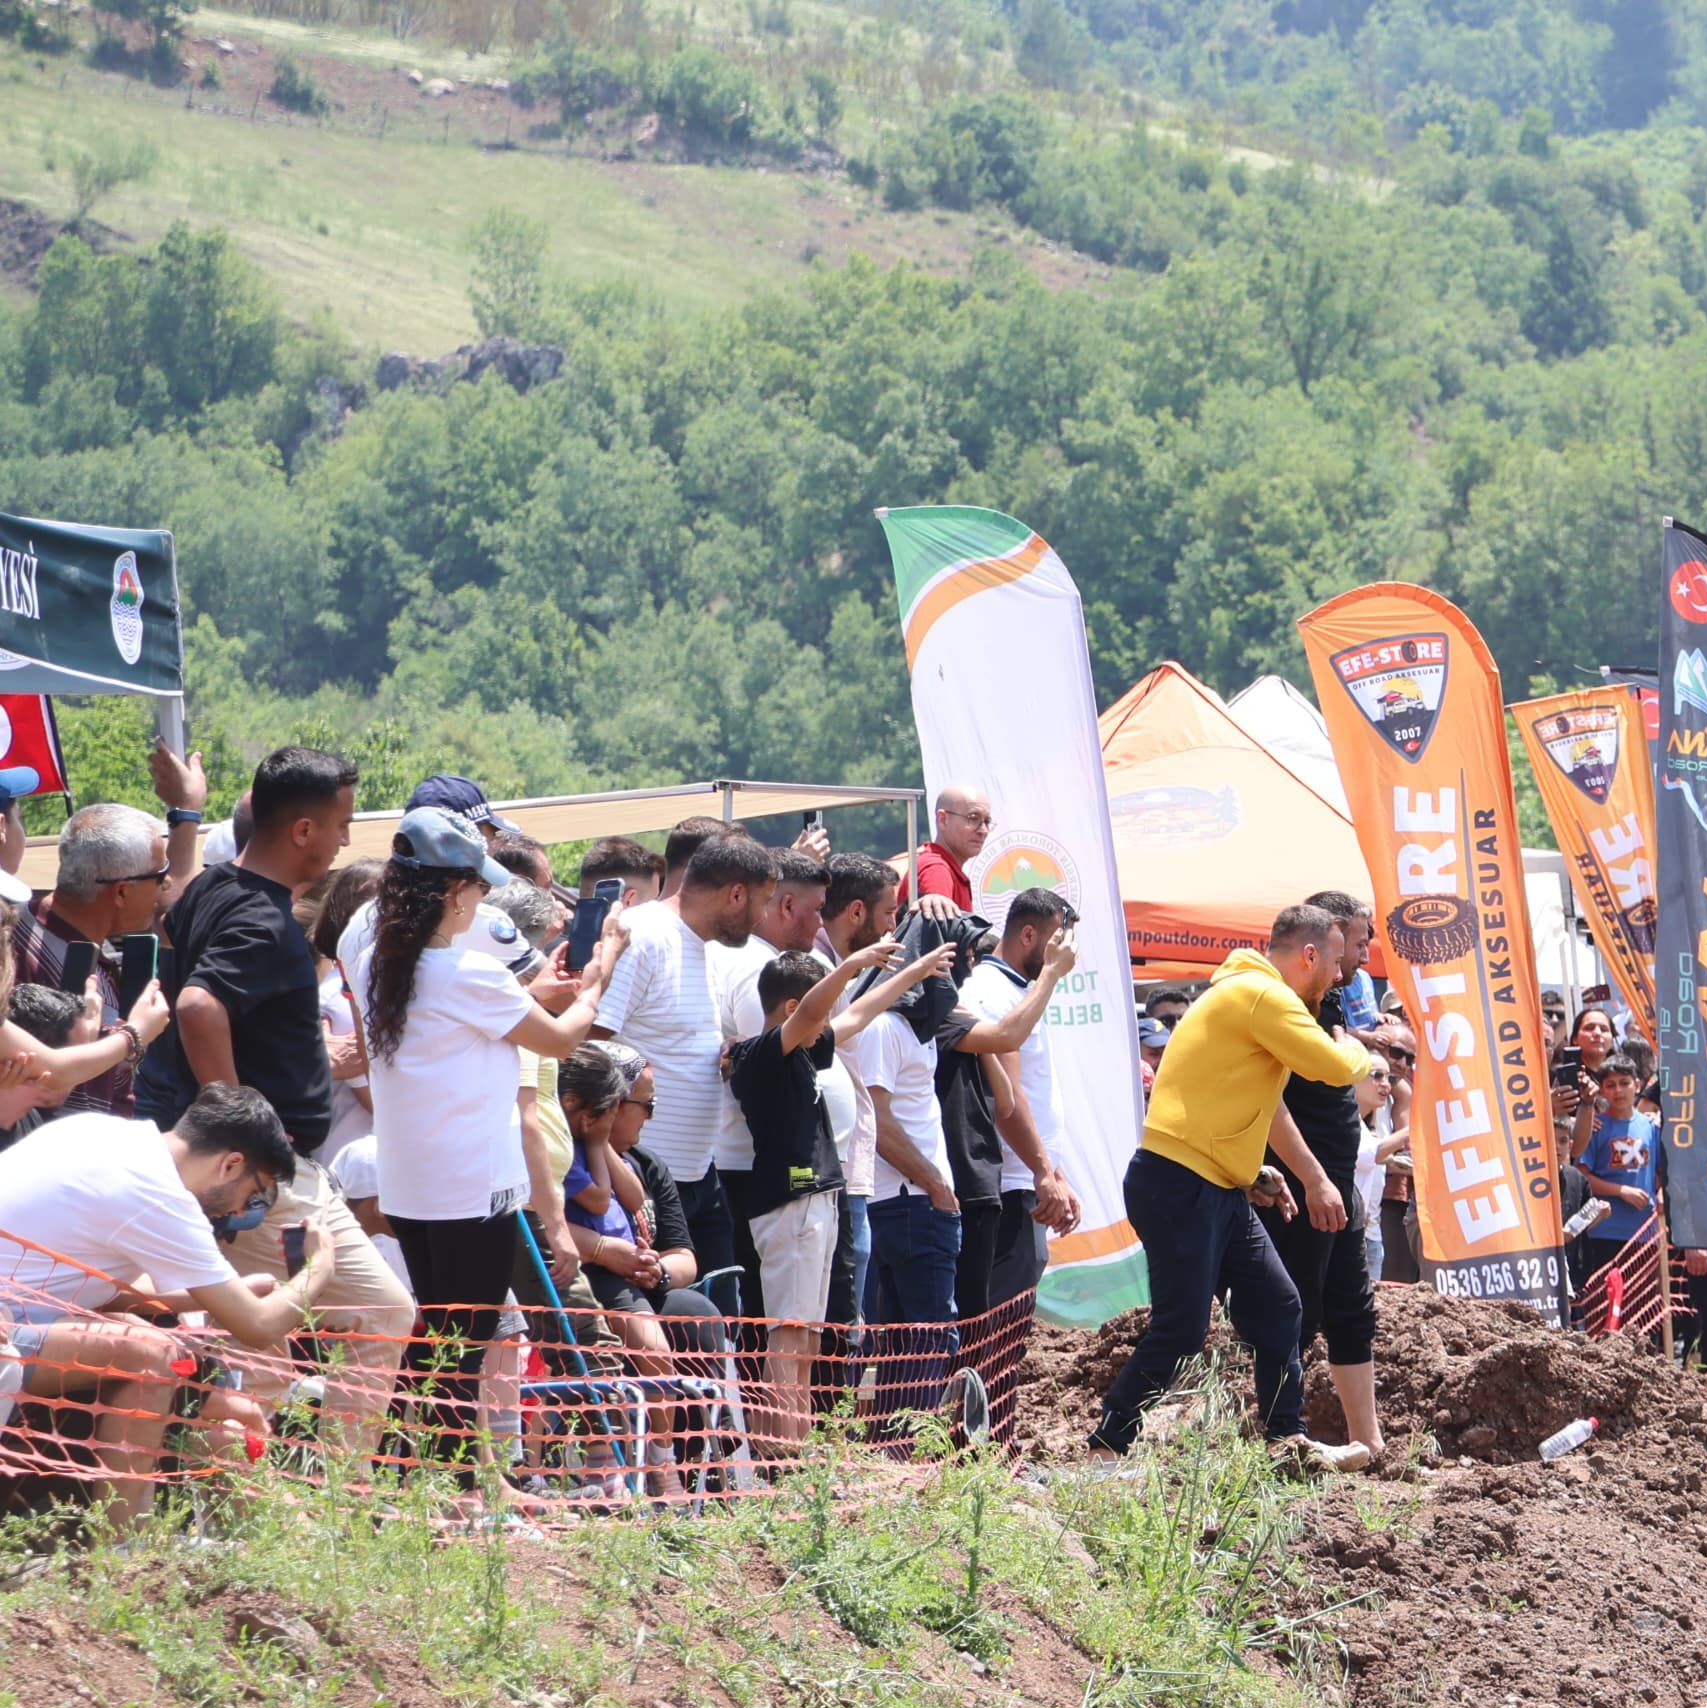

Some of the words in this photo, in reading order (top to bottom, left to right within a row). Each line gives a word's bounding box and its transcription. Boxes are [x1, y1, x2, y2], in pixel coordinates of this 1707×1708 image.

[1395, 726, 1421, 741] 2007
[1474, 807, 1515, 1004] AKSESUAR
[1127, 928, 1271, 951] mpoutdoor.com.tr
[1500, 1025, 1535, 1122] ROAD
[1519, 1139, 1551, 1200] OFF
[1435, 1267, 1482, 1297] 0536
[1482, 1261, 1516, 1295] 256
[1517, 1257, 1543, 1290] 32
[1547, 1255, 1559, 1287] 9
